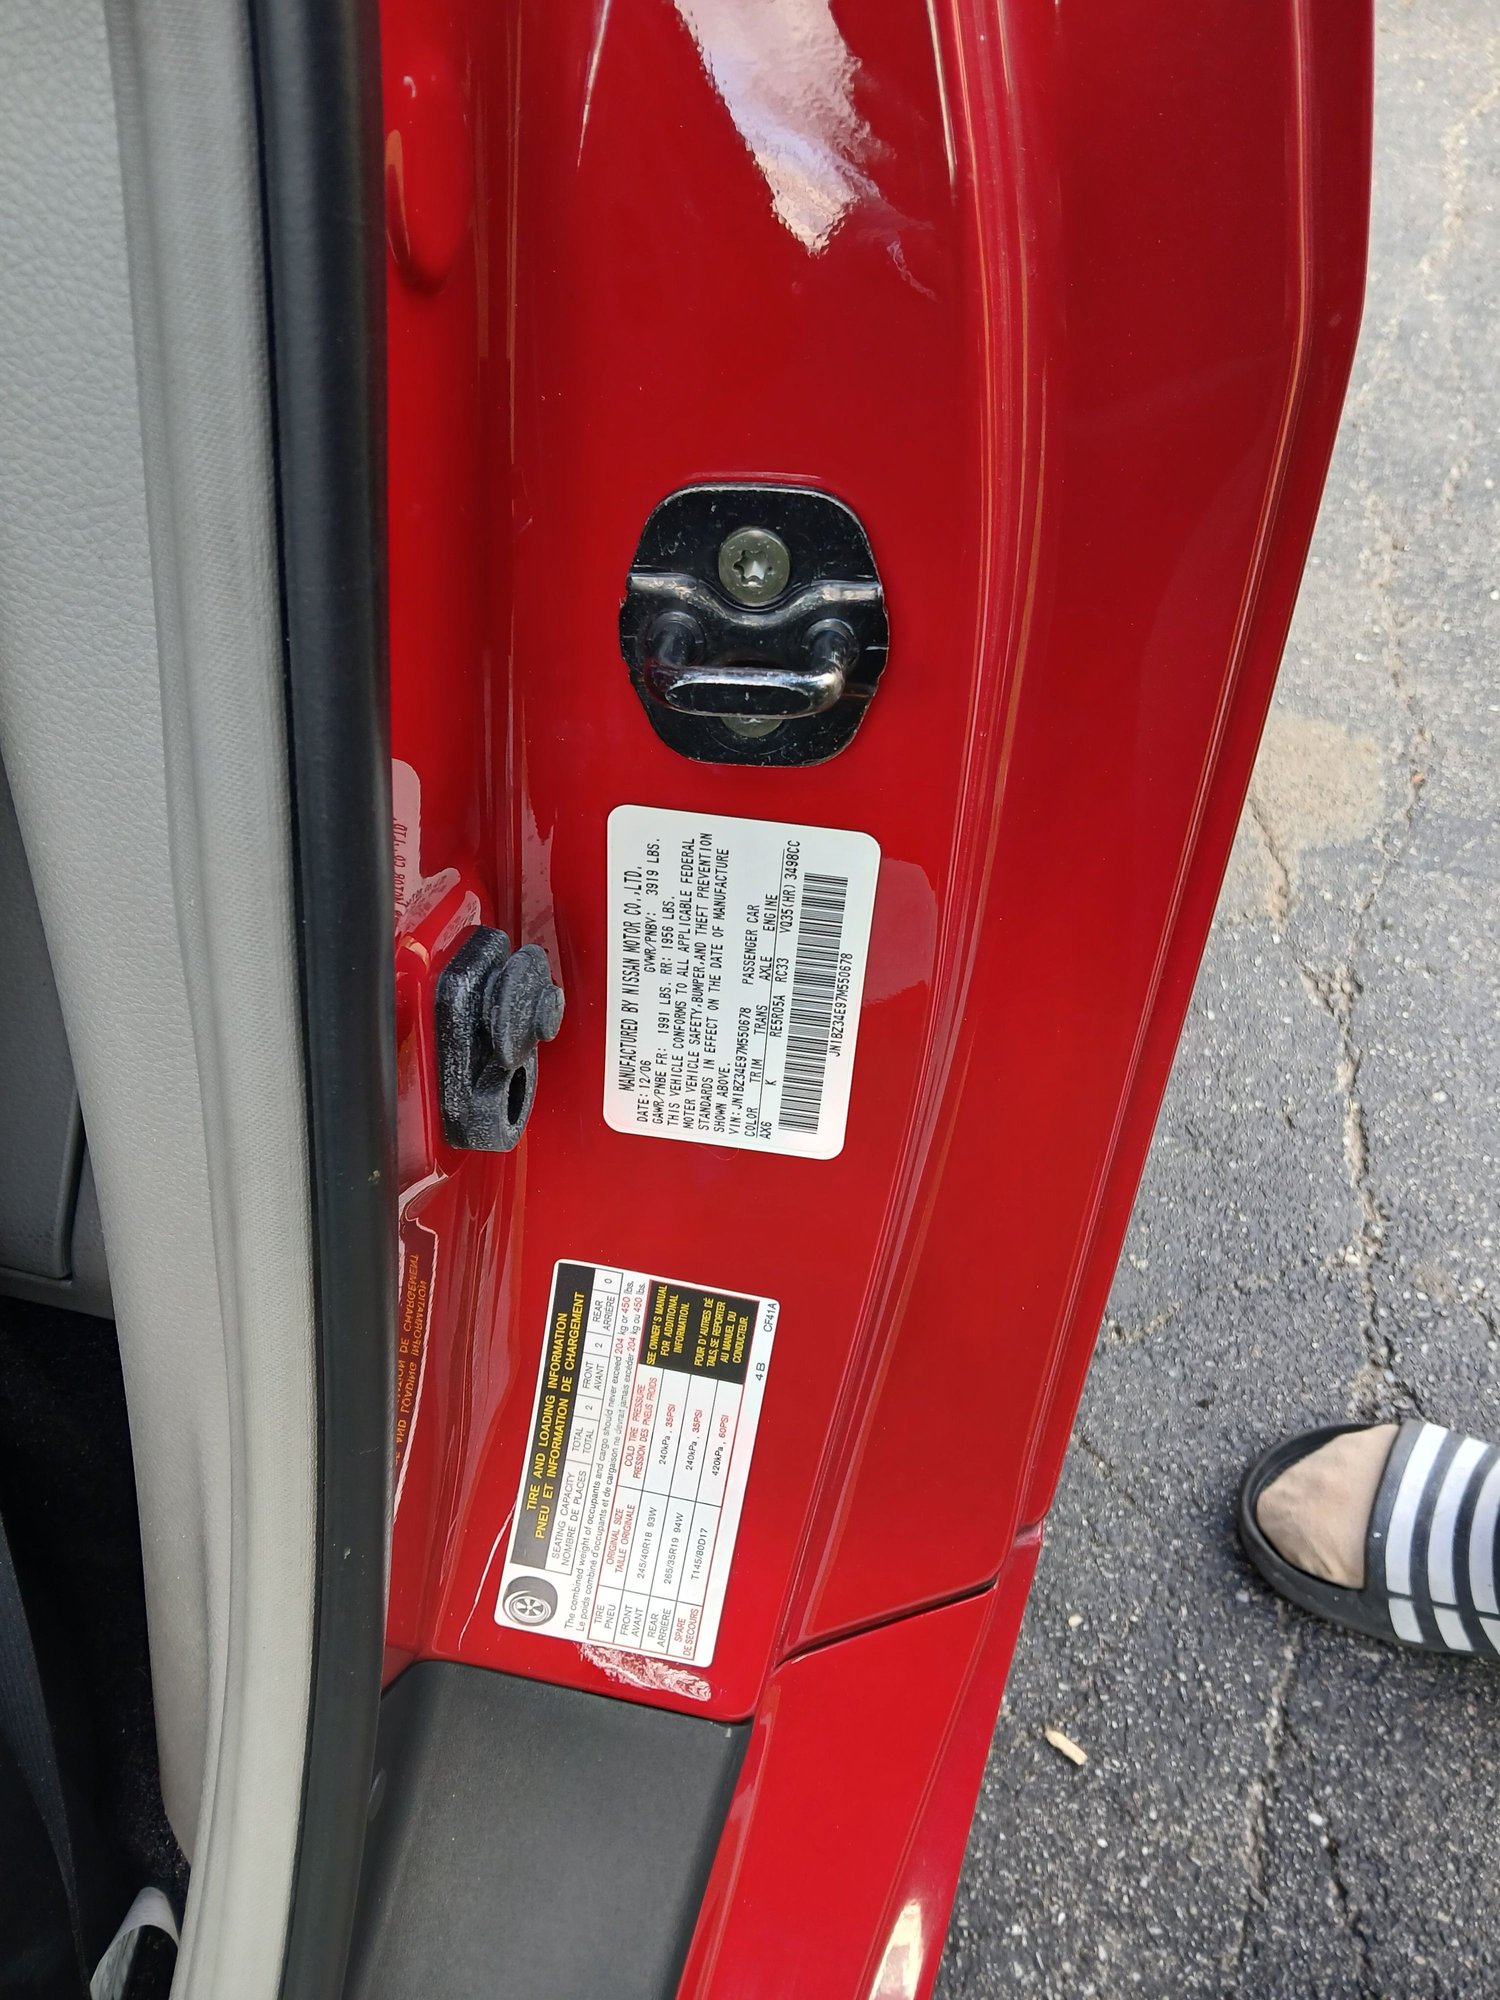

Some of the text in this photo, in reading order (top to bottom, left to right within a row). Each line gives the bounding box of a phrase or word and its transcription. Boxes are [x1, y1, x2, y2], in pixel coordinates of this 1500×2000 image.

[696, 831, 713, 899] PREVENTION
[784, 838, 800, 880] 3498CC
[643, 836, 660, 973] GVWR/PNBV: 3919 LBS.
[694, 903, 709, 936] THEFT
[745, 903, 760, 923] CAR
[778, 883, 796, 934] VQ35(HR)
[741, 928, 758, 985] PASSENGER
[774, 956, 789, 983] RC33
[617, 863, 642, 1092] MANUFACTURED BY NISSAN MOTOR CO.,LTD.
[667, 836, 695, 1127] THIS VEHICLE CONFORMS TO ALL APPLICABLE FEDERAL
[697, 847, 729, 1131] STANDARDS IN EFFECT ON THE DATE OF MANUFACTURE
[652, 894, 675, 1125] GAWR/PNBE FR: 1991 LBS. RR: 1956 LBS.
[743, 893, 778, 1137] COLOR TRIM TRANS AXLE ENGINE
[828, 951, 853, 1057] JN1BZ34E97M550678
[684, 1049, 700, 1094] VEHICLE
[764, 1078, 777, 1086] K
[636, 1058, 651, 1123] DATE: 12/06
[713, 1060, 730, 1133] SHOWN ABOVE.
[682, 1097, 696, 1130] MOTER
[759, 1120, 772, 1140] AX6
[632, 1295, 643, 1313] 450
[635, 1281, 646, 1295] lbs.
[591, 1298, 604, 1323] REAR
[632, 1313, 641, 1323] ou
[646, 1351, 657, 1365] SEE
[653, 1283, 668, 1315] MANUAL
[660, 1292, 679, 1356] FOR ADDITIONAL
[672, 1300, 691, 1354] INFORMATION.
[710, 1300, 726, 1336] REPORTER
[762, 1301, 777, 1333] CF41A
[594, 1341, 603, 1349] 2
[626, 1335, 637, 1352] 204
[629, 1324, 641, 1335] kg
[719, 1309, 737, 1363] AU MANUEL DU
[731, 1314, 749, 1364] CONDUCTEUR.
[693, 1345, 706, 1366] POUR
[581, 1360, 594, 1389] FRONT
[592, 1362, 605, 1391] AVANT
[525, 1311, 570, 1511] TIRE AND LOADING INFORMATION
[584, 1403, 593, 1411] 2
[617, 1383, 632, 1408] jamais
[534, 1290, 587, 1539] PNEU ET INFORMATION DE CHARGEMENT
[623, 1382, 646, 1467] COLD TIRE PRESSURE
[632, 1375, 658, 1479] PRESSION DES PNEUS FROIDS
[664, 1402, 677, 1428] 35PSI
[690, 1408, 703, 1433] 35PSI
[717, 1413, 730, 1438] 60PSI
[563, 1278, 634, 1630] The combined weight of occupants and cargo should never exceed 204 kg or 450 lbs.
[571, 1425, 584, 1452] TOTAL
[582, 1428, 594, 1454] TOTAL
[611, 1435, 621, 1446] ne
[604, 1446, 621, 1486] cargaison
[599, 1498, 609, 1508] et
[601, 1485, 611, 1498] de
[550, 1471, 575, 1559] SEATING CAPACITY
[560, 1469, 587, 1567] NOMBRE DE PLACES
[605, 1507, 624, 1565] ORIGINAL SIZE
[614, 1503, 636, 1574] TAILLE ORIGINALE
[635, 1506, 658, 1579] 245/40R18 93W
[662, 1511, 684, 1584] 265/35R19 94W
[690, 1526, 709, 1581] T145/80D17
[582, 1558, 597, 1595] combiné
[578, 1595, 592, 1620] poids
[593, 1603, 605, 1624] TIRE
[604, 1603, 616, 1630] PNEU
[619, 1603, 633, 1636] FRONT
[630, 1606, 644, 1637] AVANT
[646, 1611, 659, 1638] REAR
[575, 1620, 586, 1632] Le
[673, 1616, 686, 1642] SPARE
[682, 1607, 699, 1656] DE SECOURS
